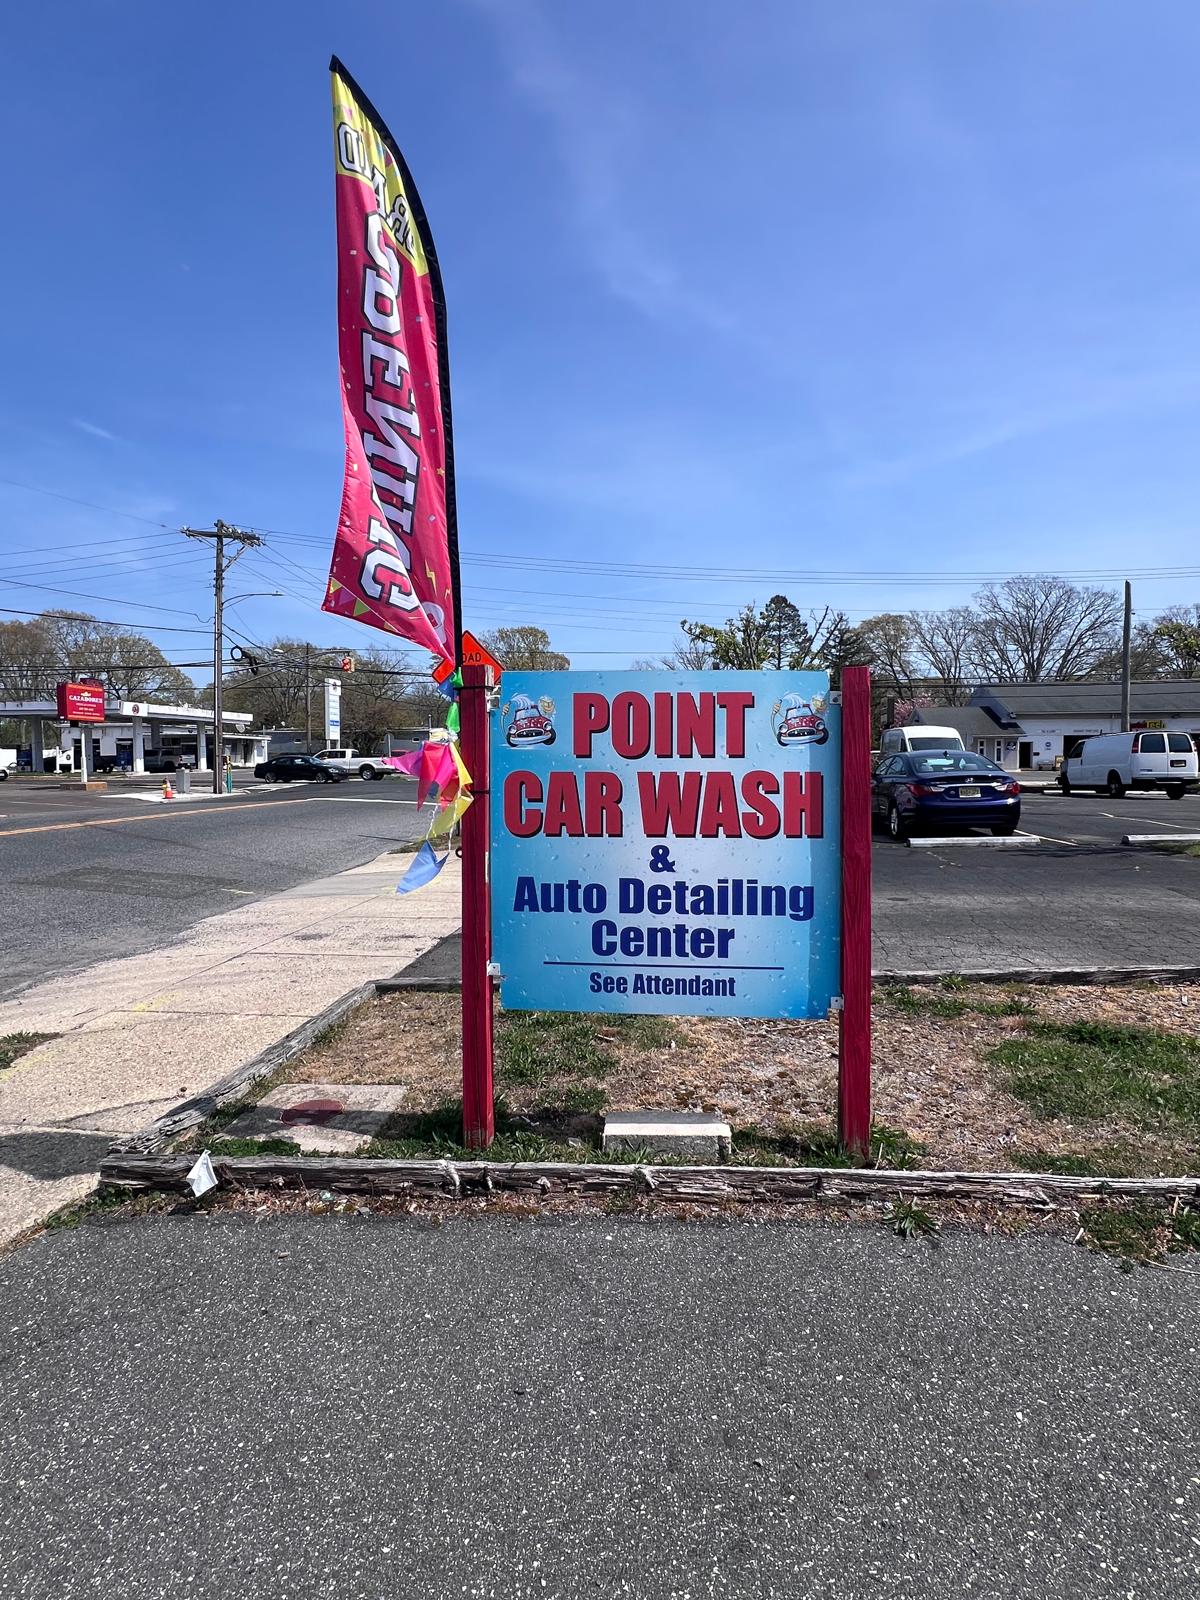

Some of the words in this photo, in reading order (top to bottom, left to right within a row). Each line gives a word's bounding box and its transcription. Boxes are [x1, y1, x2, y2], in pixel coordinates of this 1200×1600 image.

[462, 652, 482, 663] OAD
[573, 691, 754, 759] POINT
[503, 770, 623, 838] CAR
[637, 770, 824, 839] WASH
[649, 844, 676, 873] &
[513, 876, 607, 913] Auto
[619, 878, 815, 921] Detailing
[591, 919, 735, 959] Center
[590, 972, 628, 994] See
[632, 973, 736, 997] Attendant
